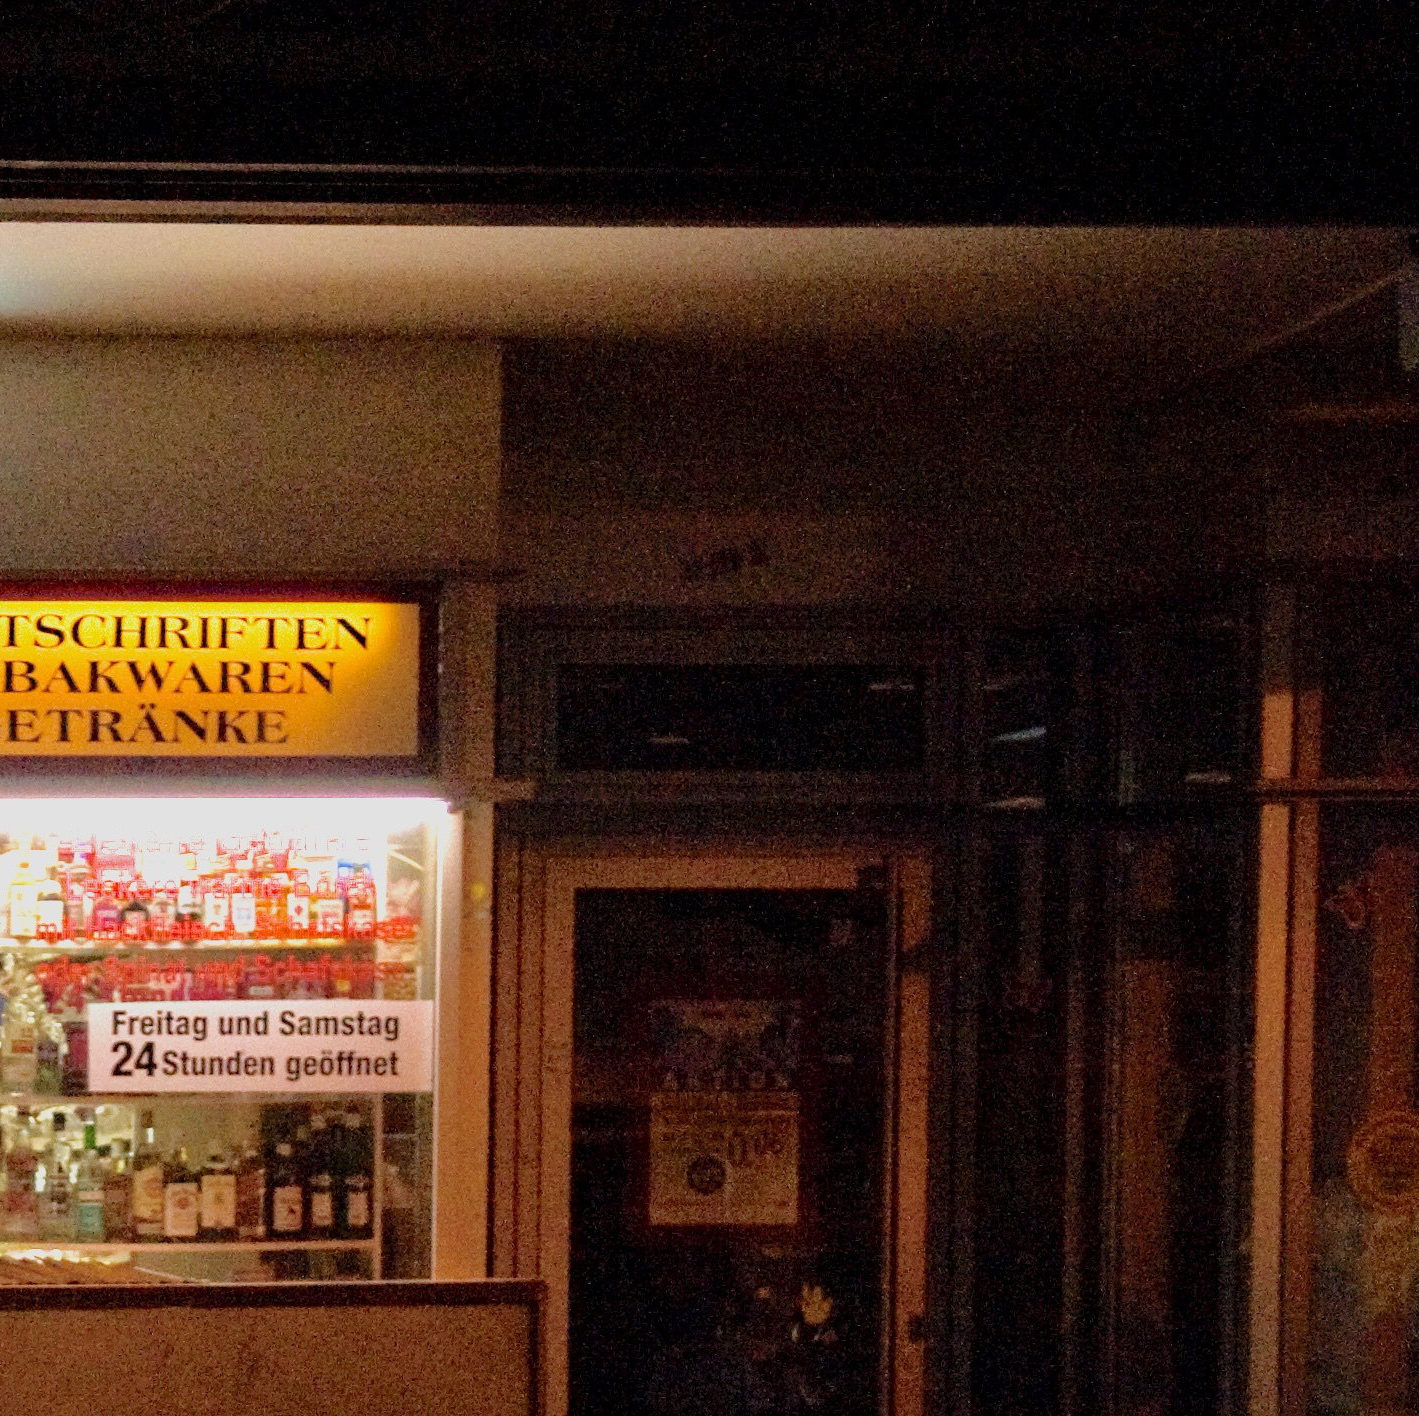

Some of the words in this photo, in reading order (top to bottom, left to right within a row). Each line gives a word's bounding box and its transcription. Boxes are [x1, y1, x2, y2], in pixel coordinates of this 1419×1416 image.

[111, 1010, 208, 1042] Freitag
[218, 1011, 269, 1036] und
[279, 1010, 400, 1042] Samstag
[111, 1041, 157, 1078] 24
[163, 1050, 276, 1077] Stunden
[285, 1050, 400, 1084] geöffnet
